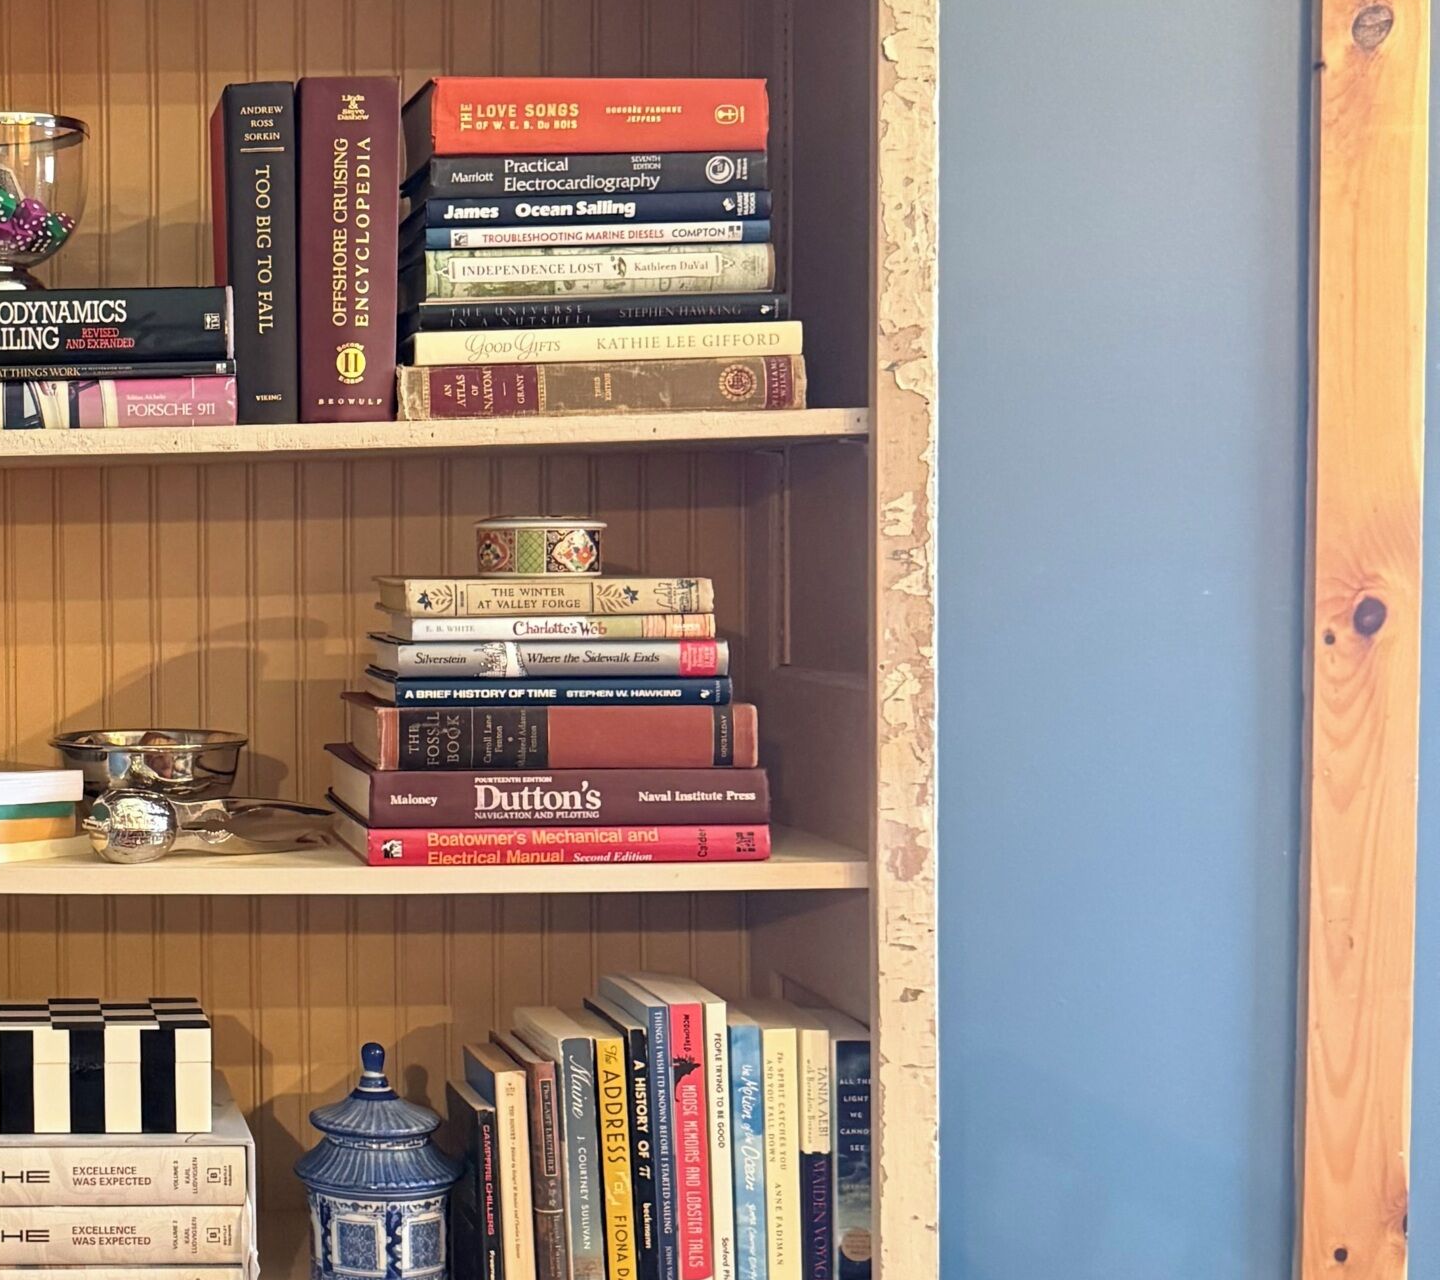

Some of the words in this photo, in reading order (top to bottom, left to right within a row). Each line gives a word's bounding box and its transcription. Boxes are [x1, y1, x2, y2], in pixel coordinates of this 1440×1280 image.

[240, 107, 284, 115] ANDREW
[460, 103, 472, 131] THE
[476, 103, 517, 118] LOVE
[524, 103, 580, 118] SONGS
[251, 119, 274, 127] ROSS
[504, 157, 568, 173] Practical
[451, 171, 494, 183] Marriott
[504, 173, 661, 192] Electrocardiography
[444, 205, 499, 220] James
[515, 203, 573, 217] Ocean
[576, 200, 636, 218] Sailing
[354, 137, 371, 327] ENCYCLOPEDIA
[482, 231, 583, 243] TROUBLESHOOTING
[585, 230, 625, 241] MARINE
[628, 229, 664, 239] DIESELS
[671, 227, 725, 238] COMPTON
[462, 264, 565, 277] INDEPENDENCE
[570, 262, 603, 274] LOST
[634, 262, 676, 271] Kathleen
[680, 261, 709, 270] DuVal
[619, 307, 674, 318] STEPHEN
[679, 304, 741, 316] HAWKING
[82, 328, 120, 338] REVISED
[65, 339, 86, 349] AND
[87, 337, 135, 349] EXPANDED
[444, 384, 452, 397] AN
[516, 373, 525, 404] GRANT
[491, 588, 514, 597] THE
[520, 587, 565, 596] WINTER
[477, 600, 491, 609] AT
[496, 599, 537, 609] VALLEY
[542, 599, 581, 608] FORGE
[638, 790, 671, 802] Naval
[674, 790, 723, 802] Institute
[726, 790, 756, 801] Press
[474, 812, 532, 820] NAVIGATION
[534, 811, 554, 819] AND
[556, 811, 599, 819] PILOTING
[427, 831, 527, 847] Boatowner's
[532, 829, 622, 845] Mechanical
[627, 828, 659, 842] and
[427, 850, 501, 865] Electrical
[506, 849, 564, 864] Manual
[573, 852, 610, 862] Second
[613, 851, 652, 862] Edition
[714, 1033, 722, 1062] PEOPLE
[766, 1059, 774, 1079] AND
[715, 1065, 723, 1093] TRYING
[817, 1066, 827, 1105] TANIA
[682, 1084, 698, 1116] MOOSE
[717, 1096, 724, 1107] TO
[717, 1110, 724, 1119] BE
[818, 1109, 828, 1137] AEBI
[683, 1120, 700, 1163] MEMOIRS
[717, 1122, 725, 1149] GOOD
[768, 1133, 776, 1162] DOWN
[73, 1166, 137, 1176] EXCELLENCE
[686, 1167, 700, 1187] AND
[73, 1177, 97, 1186] WAS
[99, 1176, 152, 1186] EXPECTED
[686, 1191, 702, 1234] LOBSTER
[72, 1226, 136, 1235] EXCELLENCE
[642, 1202, 653, 1249] beckmann
[72, 1237, 96, 1246] WAS
[98, 1236, 151, 1245] EXPECTED
[614, 1215, 628, 1263] FIONA
[775, 1216, 783, 1266] FADIMAN
[688, 1238, 704, 1267] TALES
[721, 1237, 730, 1267] Sanford
